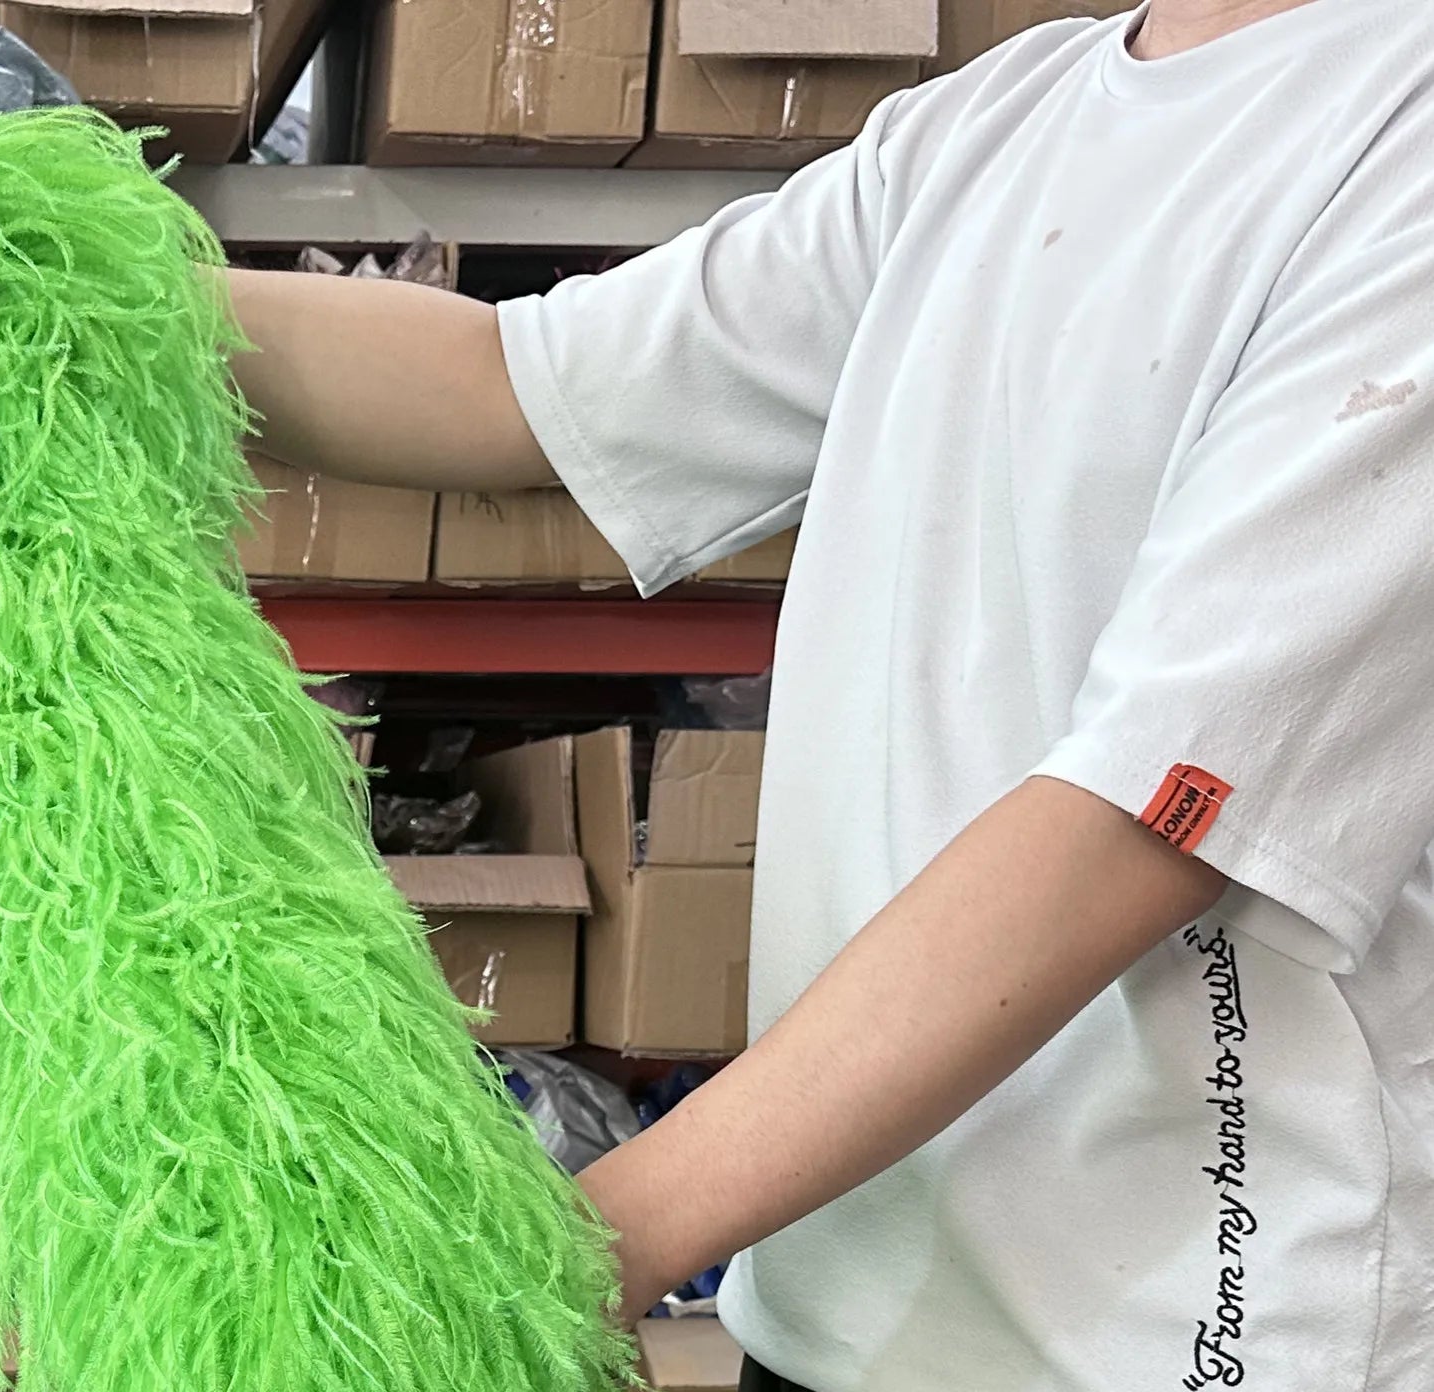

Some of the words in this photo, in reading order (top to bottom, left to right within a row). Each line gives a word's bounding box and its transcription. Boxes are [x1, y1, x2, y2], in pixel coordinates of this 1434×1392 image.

[1205, 1047, 1244, 1092] to
[1202, 1096, 1246, 1188] hand
[1217, 1193, 1258, 1255] my
